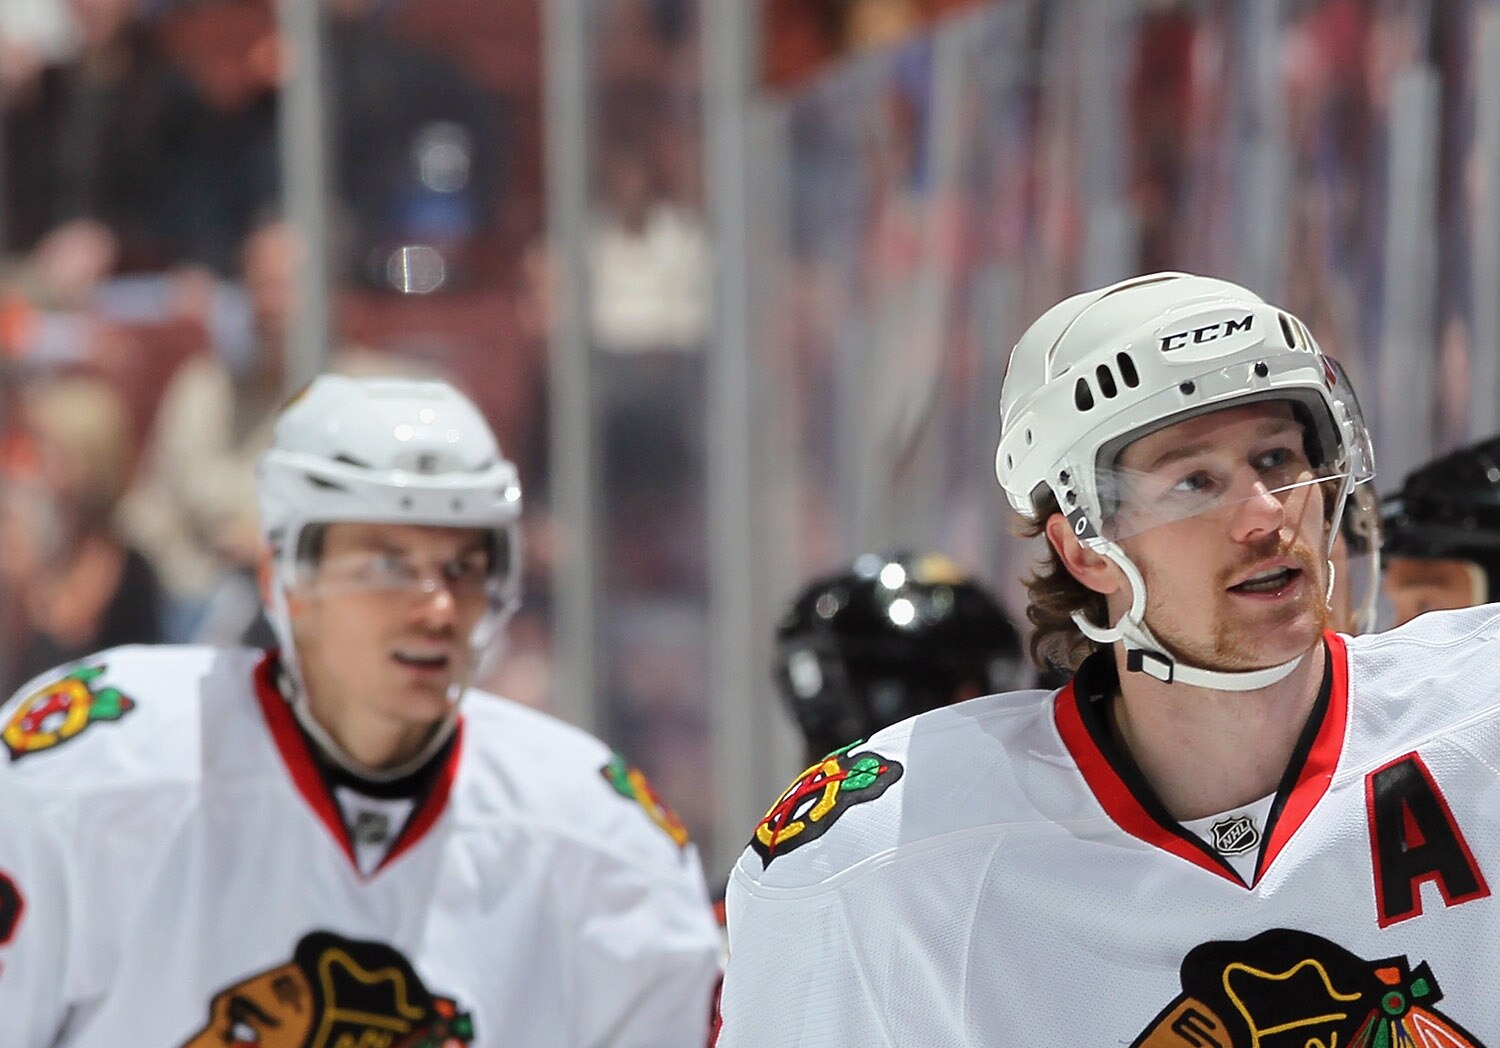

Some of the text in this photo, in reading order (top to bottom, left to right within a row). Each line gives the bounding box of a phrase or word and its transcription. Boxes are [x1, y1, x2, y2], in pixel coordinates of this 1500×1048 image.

[1158, 314, 1254, 351] CCM
[1222, 820, 1249, 848] NHL
[1365, 750, 1492, 930] A
